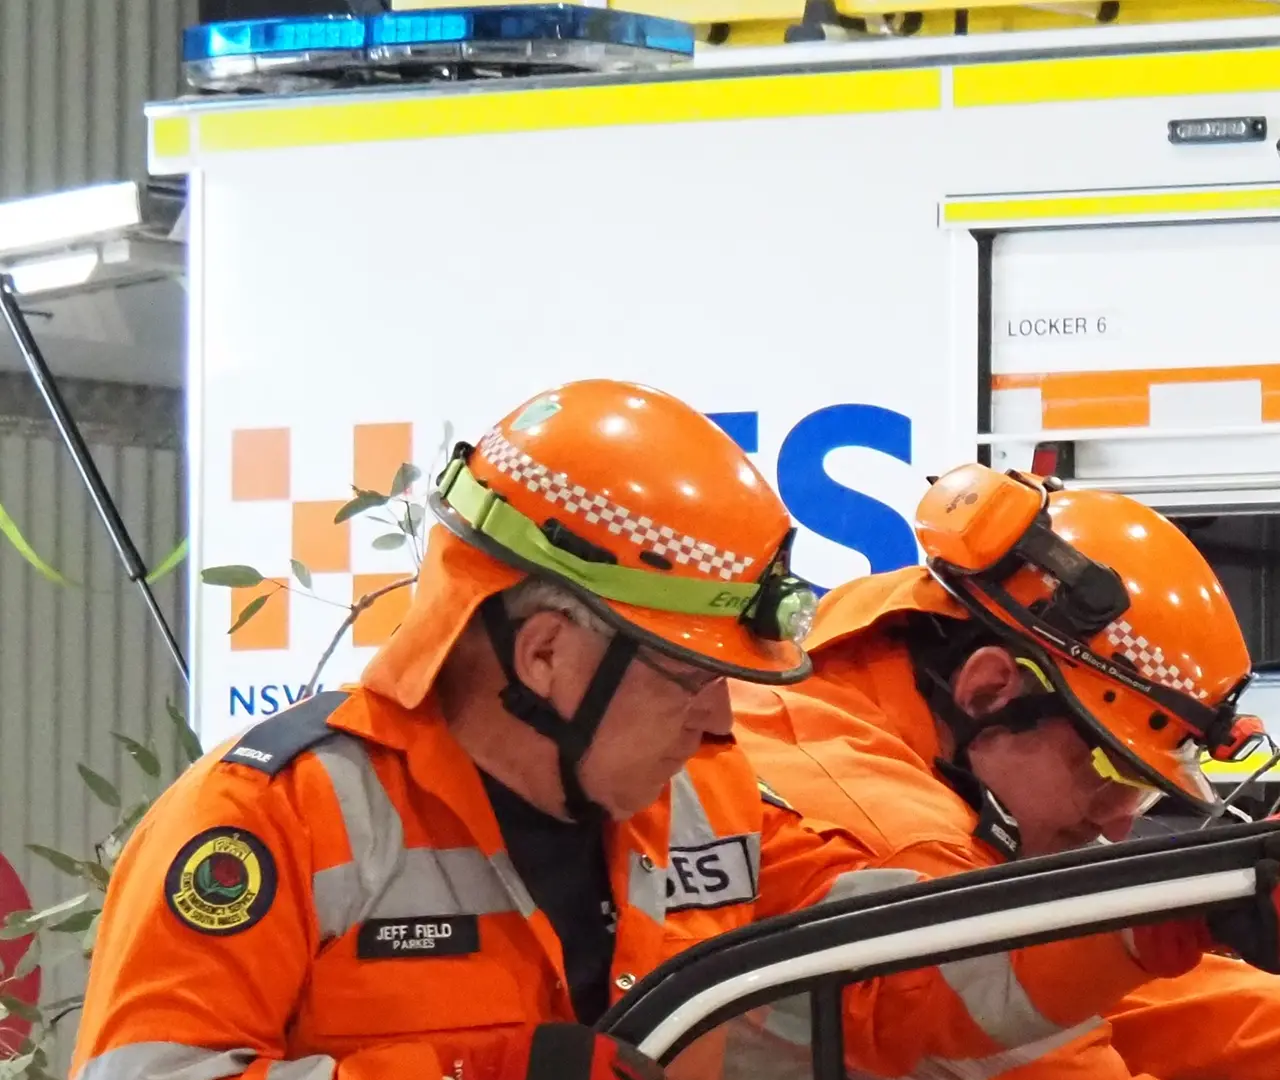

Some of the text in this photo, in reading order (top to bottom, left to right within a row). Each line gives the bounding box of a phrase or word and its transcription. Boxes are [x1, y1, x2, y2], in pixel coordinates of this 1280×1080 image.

[1007, 316, 1107, 337] LOCKER 6
[1081, 651, 1152, 693] Black Diamond
[376, 923, 453, 940] JEFF FIELD
[392, 938, 436, 950] PARKES
